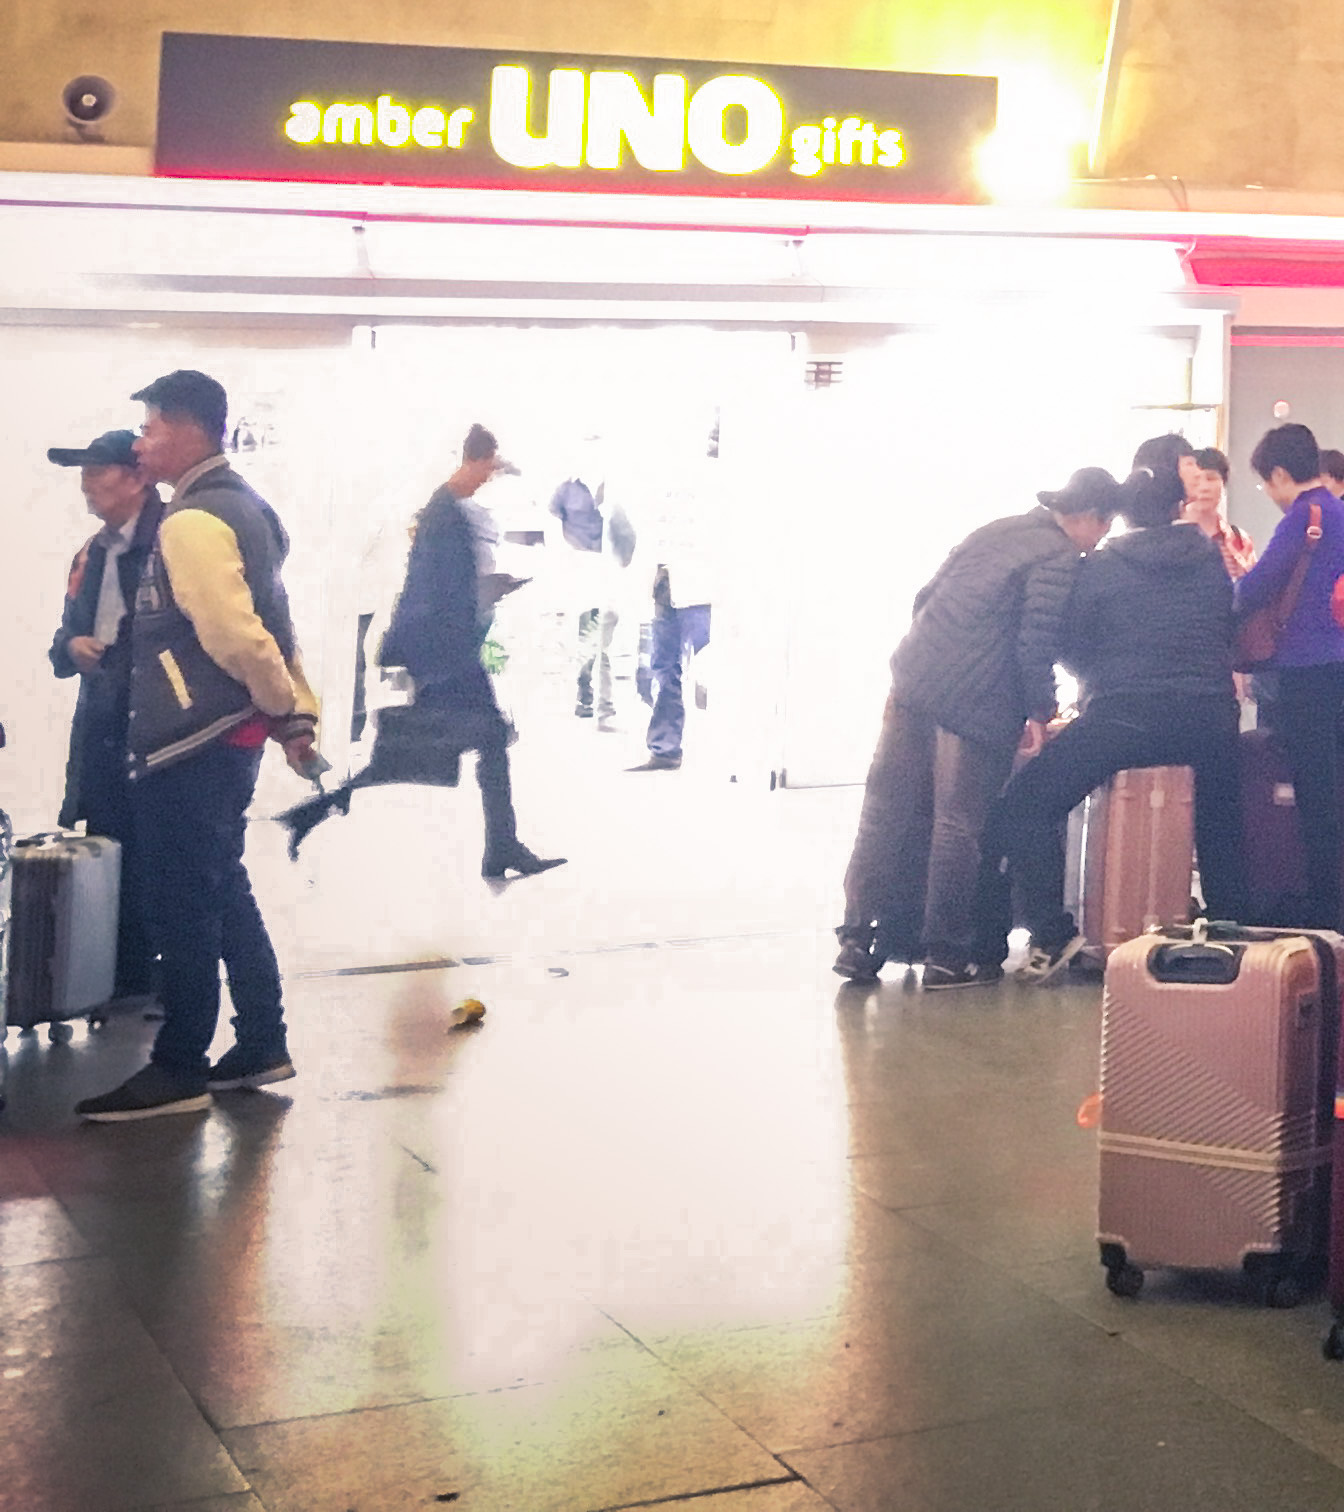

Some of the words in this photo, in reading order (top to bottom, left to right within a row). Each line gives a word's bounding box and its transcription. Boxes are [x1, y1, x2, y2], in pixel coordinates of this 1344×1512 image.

[284, 95, 474, 150] amber
[490, 65, 783, 175] UNO
[789, 115, 905, 178] gifts
